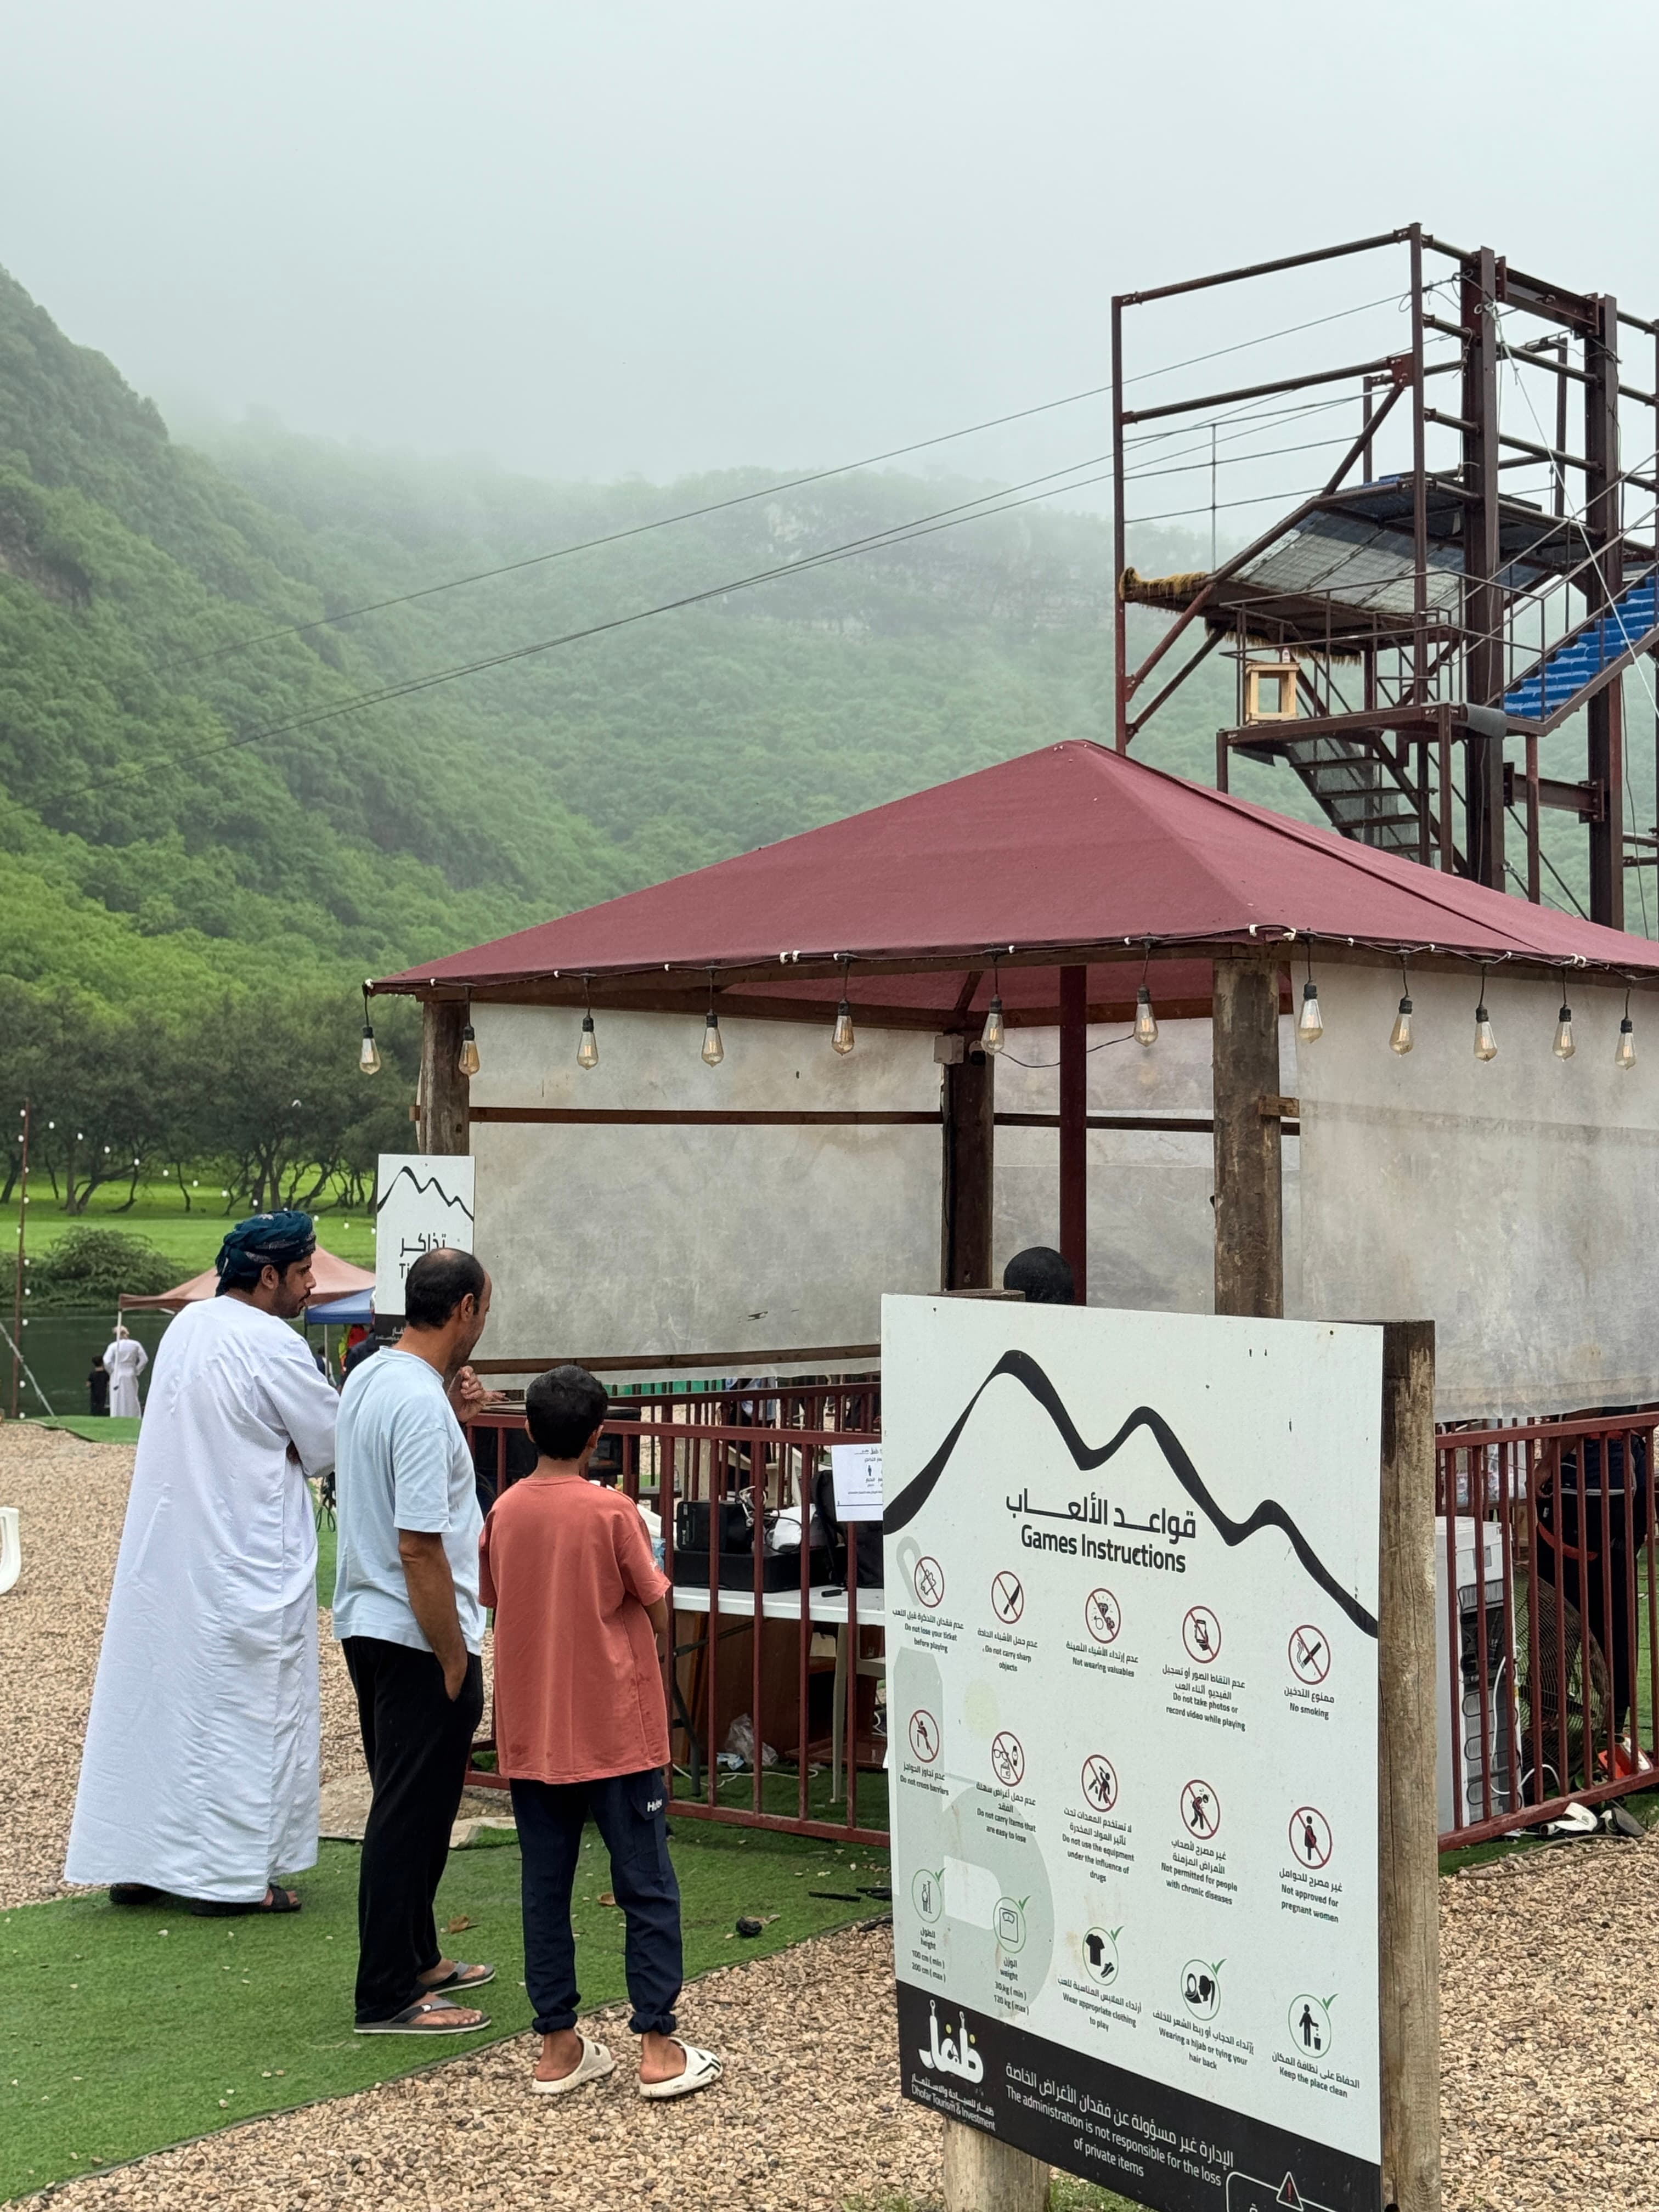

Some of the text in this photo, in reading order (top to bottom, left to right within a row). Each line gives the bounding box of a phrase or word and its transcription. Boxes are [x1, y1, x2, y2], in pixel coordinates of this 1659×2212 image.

[1006, 1487, 1196, 1544] قواعد الألعاب
[1021, 1523, 1186, 1573] Games Instructions
[998, 1662, 1018, 1672] objects
[1003, 1650, 1016, 1660] carry
[1017, 1652, 1031, 1664] sharp
[1073, 1657, 1135, 1677] Not wearing valuables
[1162, 1664, 1245, 1689] عدم التقاط الصور أو تسجيل
[1173, 1692, 1181, 1701] Do
[1182, 1696, 1193, 1705] not
[1194, 1697, 1207, 1706] take
[1209, 1701, 1230, 1712] photos
[1284, 1686, 1334, 1703] ممنوع التدخين
[1166, 1706, 1245, 1732] record video while playing
[1290, 1702, 1329, 1720] No smoking
[977, 1808, 1036, 1832] Do not carry items that
[986, 1825, 1026, 1843] are easy to lose
[1062, 1833, 1135, 1861] Do not use the equipment
[1068, 1850, 1084, 1860] under
[1085, 1855, 1094, 1864] the
[1096, 1857, 1122, 1872] influence
[1090, 1870, 1106, 1883] drugs
[1161, 1862, 1238, 1892] Not permitted for people
[1279, 1867, 1342, 1893] غير مصرح للحوامل
[1166, 1879, 1233, 1905] with chronic diseases
[1282, 1883, 1339, 1908] Not approved for
[1281, 1901, 1339, 1923] pregnant women
[1063, 1992, 1136, 2028] Wear appropriate clothing
[1090, 2017, 1109, 2033] to play
[1159, 2027, 1185, 2046] Wearing
[1191, 2038, 1206, 2051] hijab
[1216, 2048, 1232, 2063] tying
[1233, 2055, 1248, 2066] your
[1189, 2052, 1217, 2070] hair back
[1272, 2051, 1359, 2089] الحفاظ على نظافة المكان
[1279, 2066, 1348, 2098] Keep the place clean
[911, 2084, 996, 2131] Dhofar Tourism & Investment
[1006, 2062, 1233, 2170] الإدارة غير مسؤولة عن فقدان الأغراض الخاصة
[1006, 2084, 1222, 2186] The administration is not responsible for the loss
[1074, 2138, 1144, 2177] of private items
